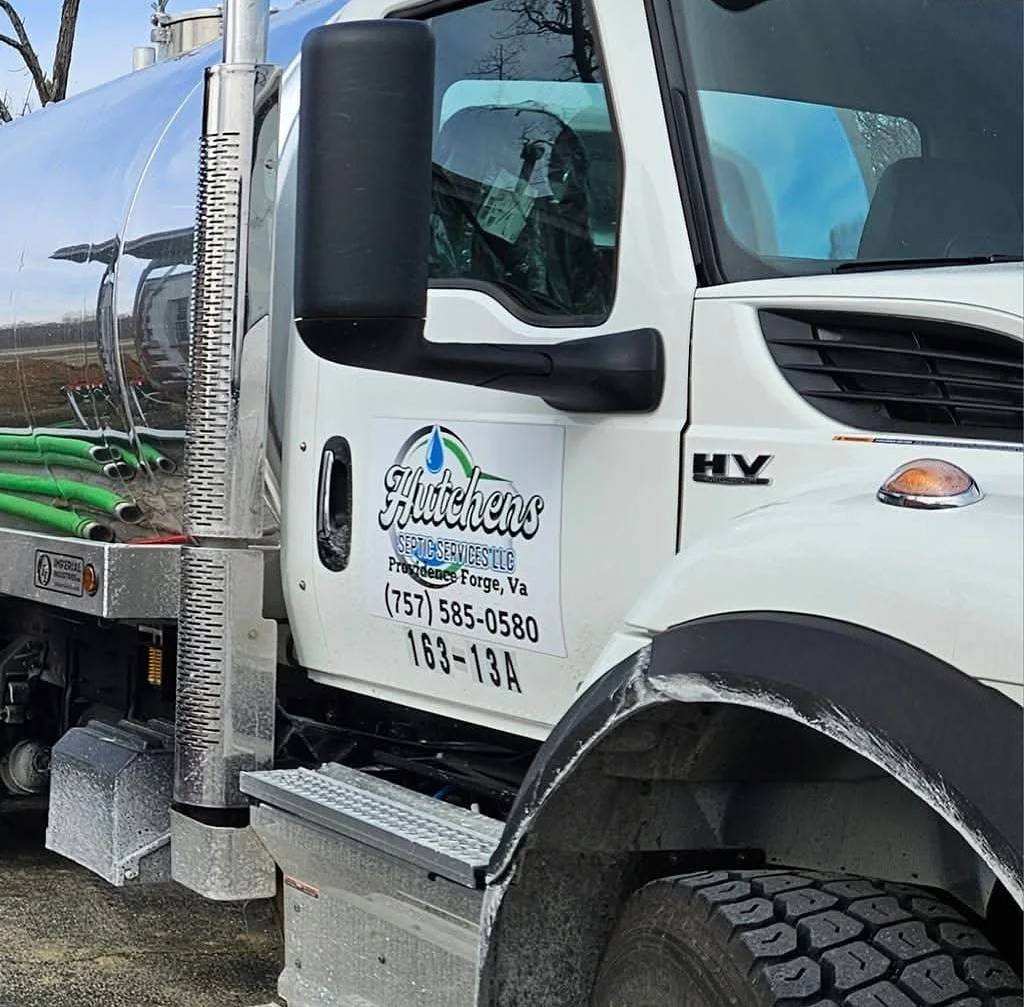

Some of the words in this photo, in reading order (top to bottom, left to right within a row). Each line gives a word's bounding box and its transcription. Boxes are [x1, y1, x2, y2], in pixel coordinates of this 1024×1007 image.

[693, 452, 774, 478] HV
[378, 464, 544, 539] Hutchens
[388, 556, 458, 583] Providence
[460, 568, 504, 596] Forge,
[507, 576, 529, 596] Va
[397, 533, 434, 559] SEPTIC
[436, 538, 490, 568] SERVICES
[491, 546, 516, 572] LLC
[384, 582, 433, 626] (757)
[438, 598, 539, 644] 585-0580
[407, 628, 523, 694] 163-13A
